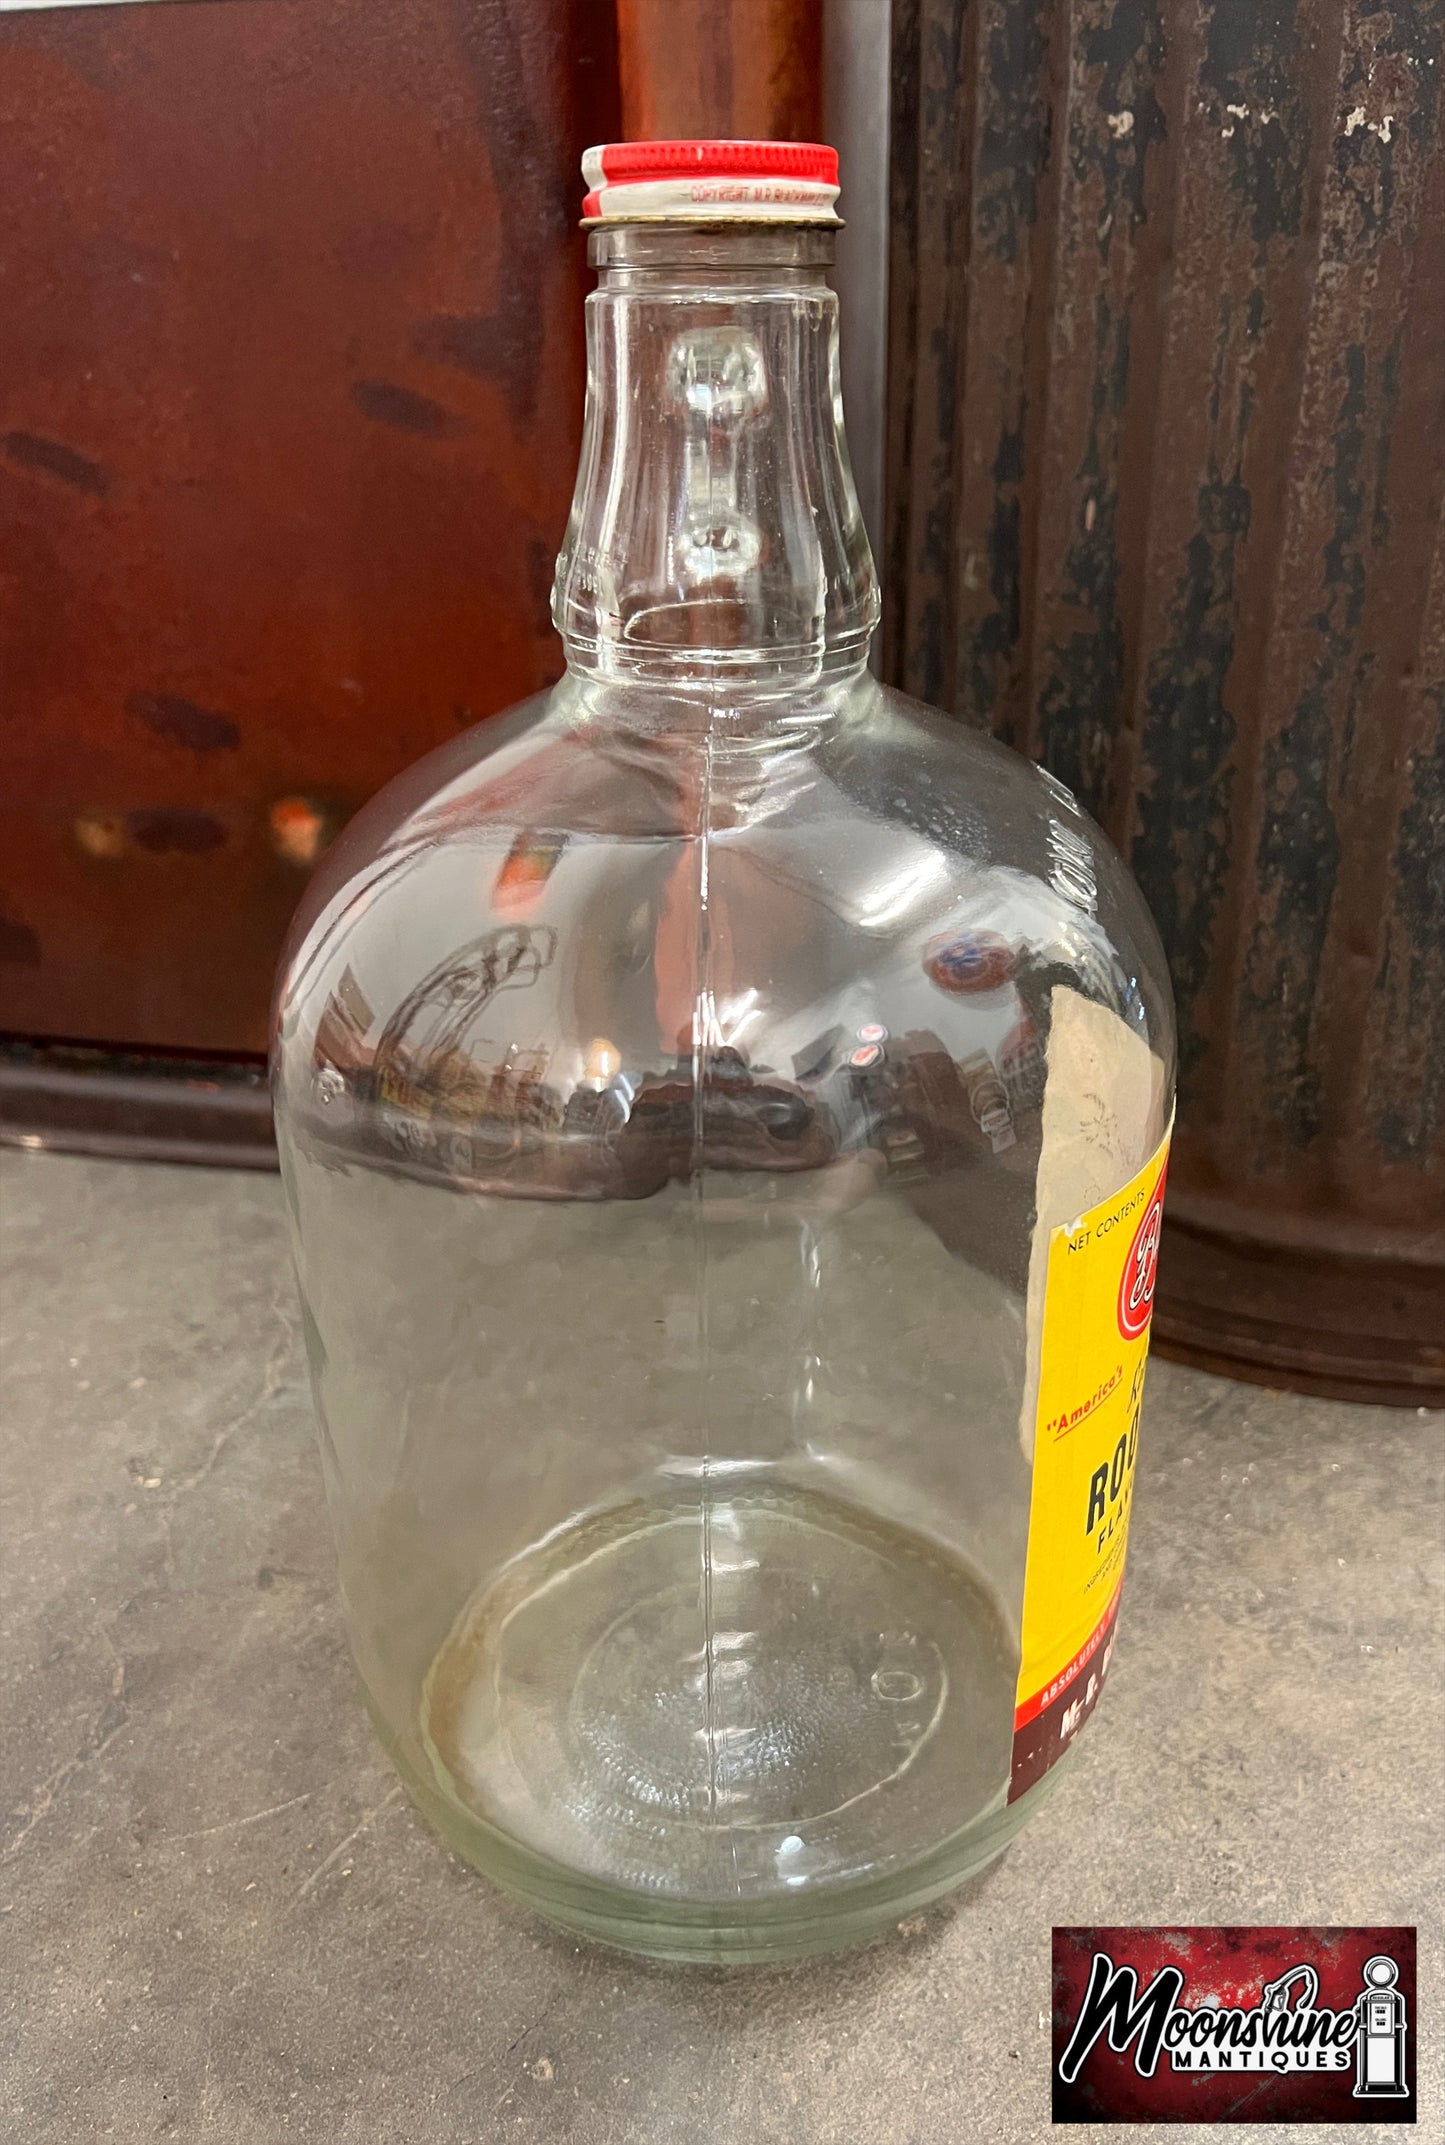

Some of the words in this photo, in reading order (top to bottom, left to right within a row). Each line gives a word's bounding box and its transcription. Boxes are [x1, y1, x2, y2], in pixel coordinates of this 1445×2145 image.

[1067, 1232, 1091, 1255] NET
[1096, 1187, 1145, 1238] CONTENTS
[1041, 1622, 1106, 1707] ABSOLUTELY
